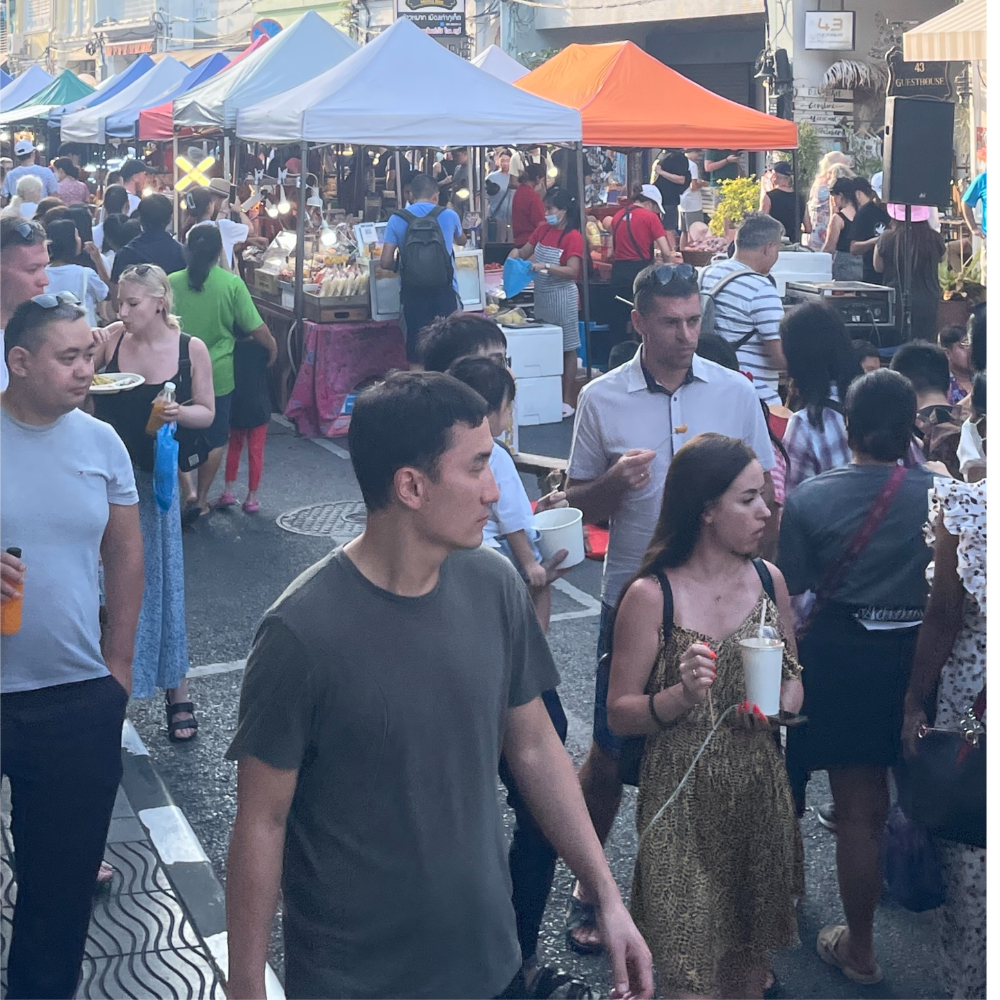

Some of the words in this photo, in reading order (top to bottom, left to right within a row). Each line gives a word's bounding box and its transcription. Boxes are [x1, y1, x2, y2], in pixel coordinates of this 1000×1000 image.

[818, 17, 843, 31] 43
[914, 62, 925, 72] 43
[895, 77, 945, 87] GUESTHOUSE
